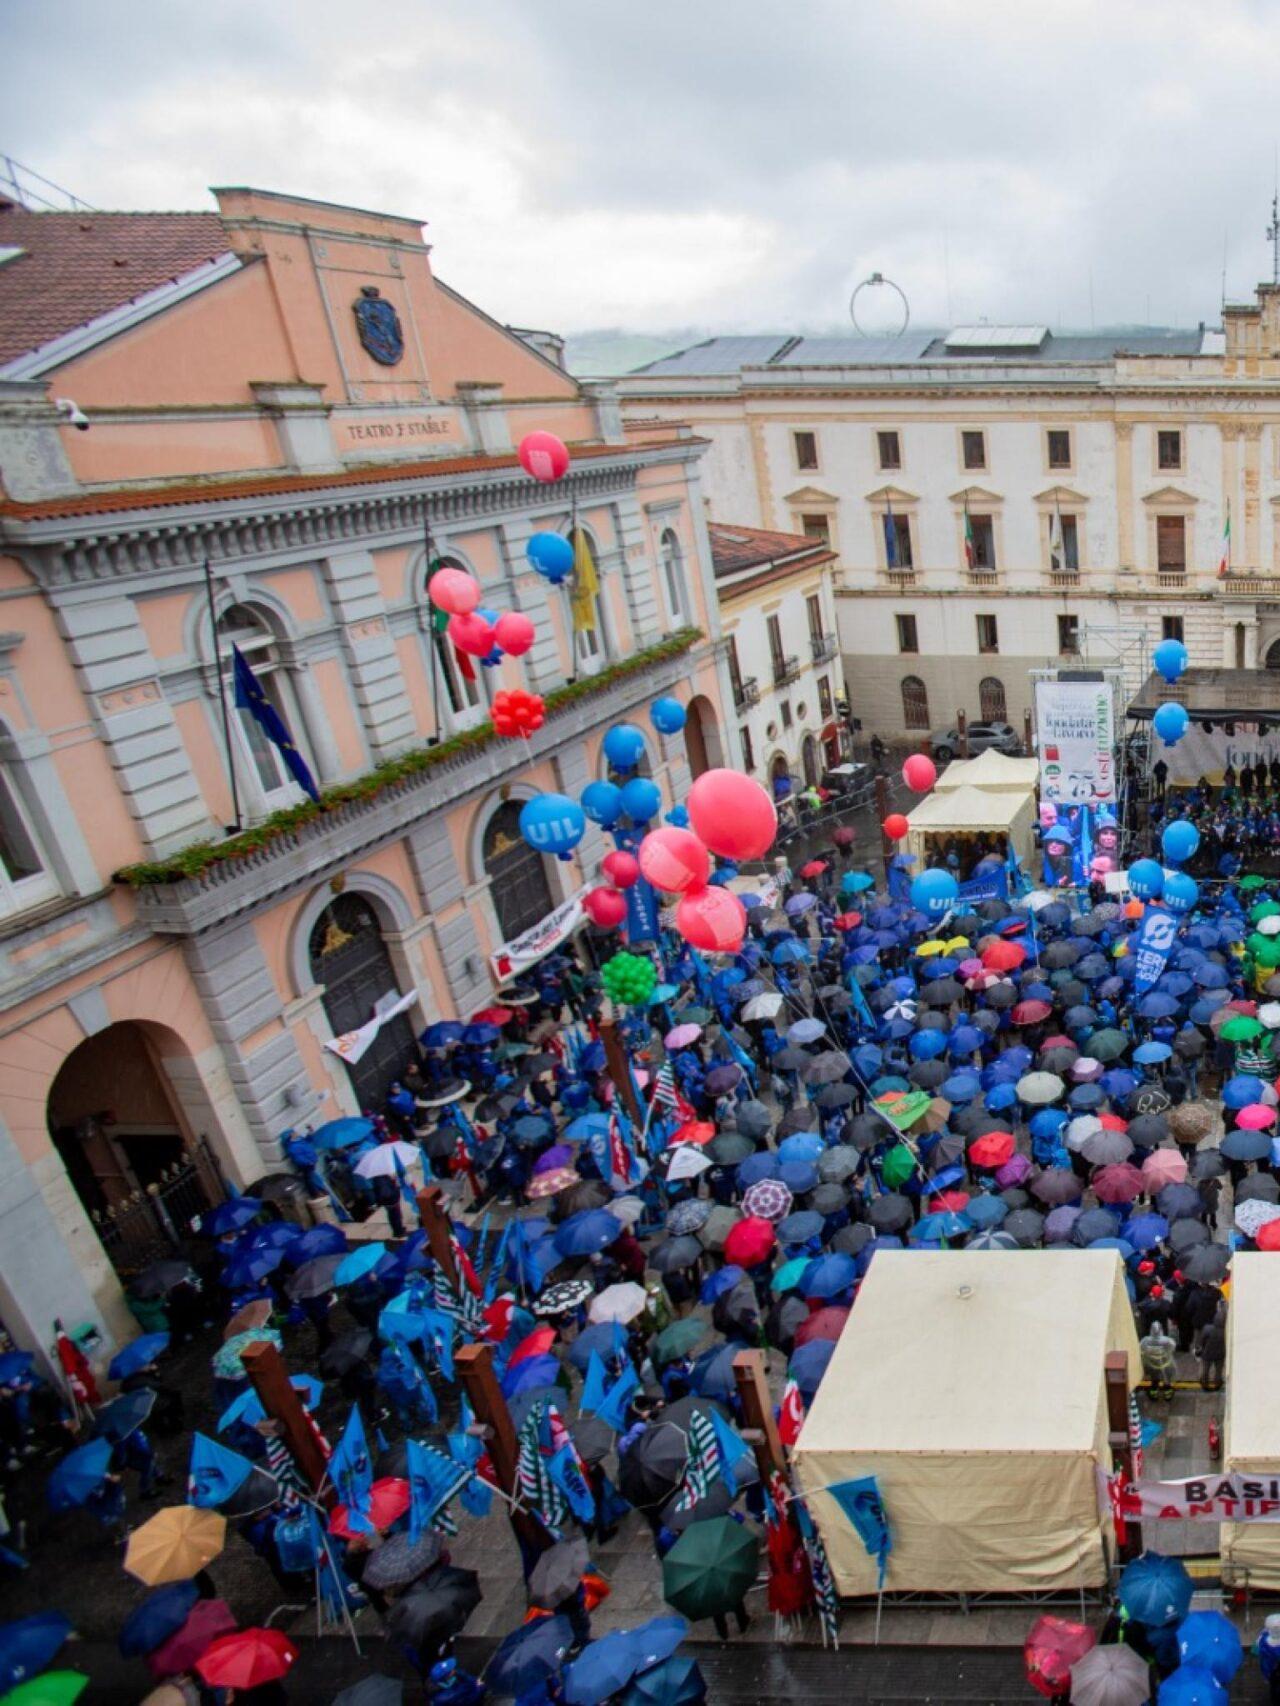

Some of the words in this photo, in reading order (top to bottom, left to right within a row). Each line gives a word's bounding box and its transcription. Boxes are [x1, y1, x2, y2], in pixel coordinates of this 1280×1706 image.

[347, 424, 394, 439] TEATRO
[408, 420, 450, 436] STABILE
[527, 817, 580, 845] UIL
